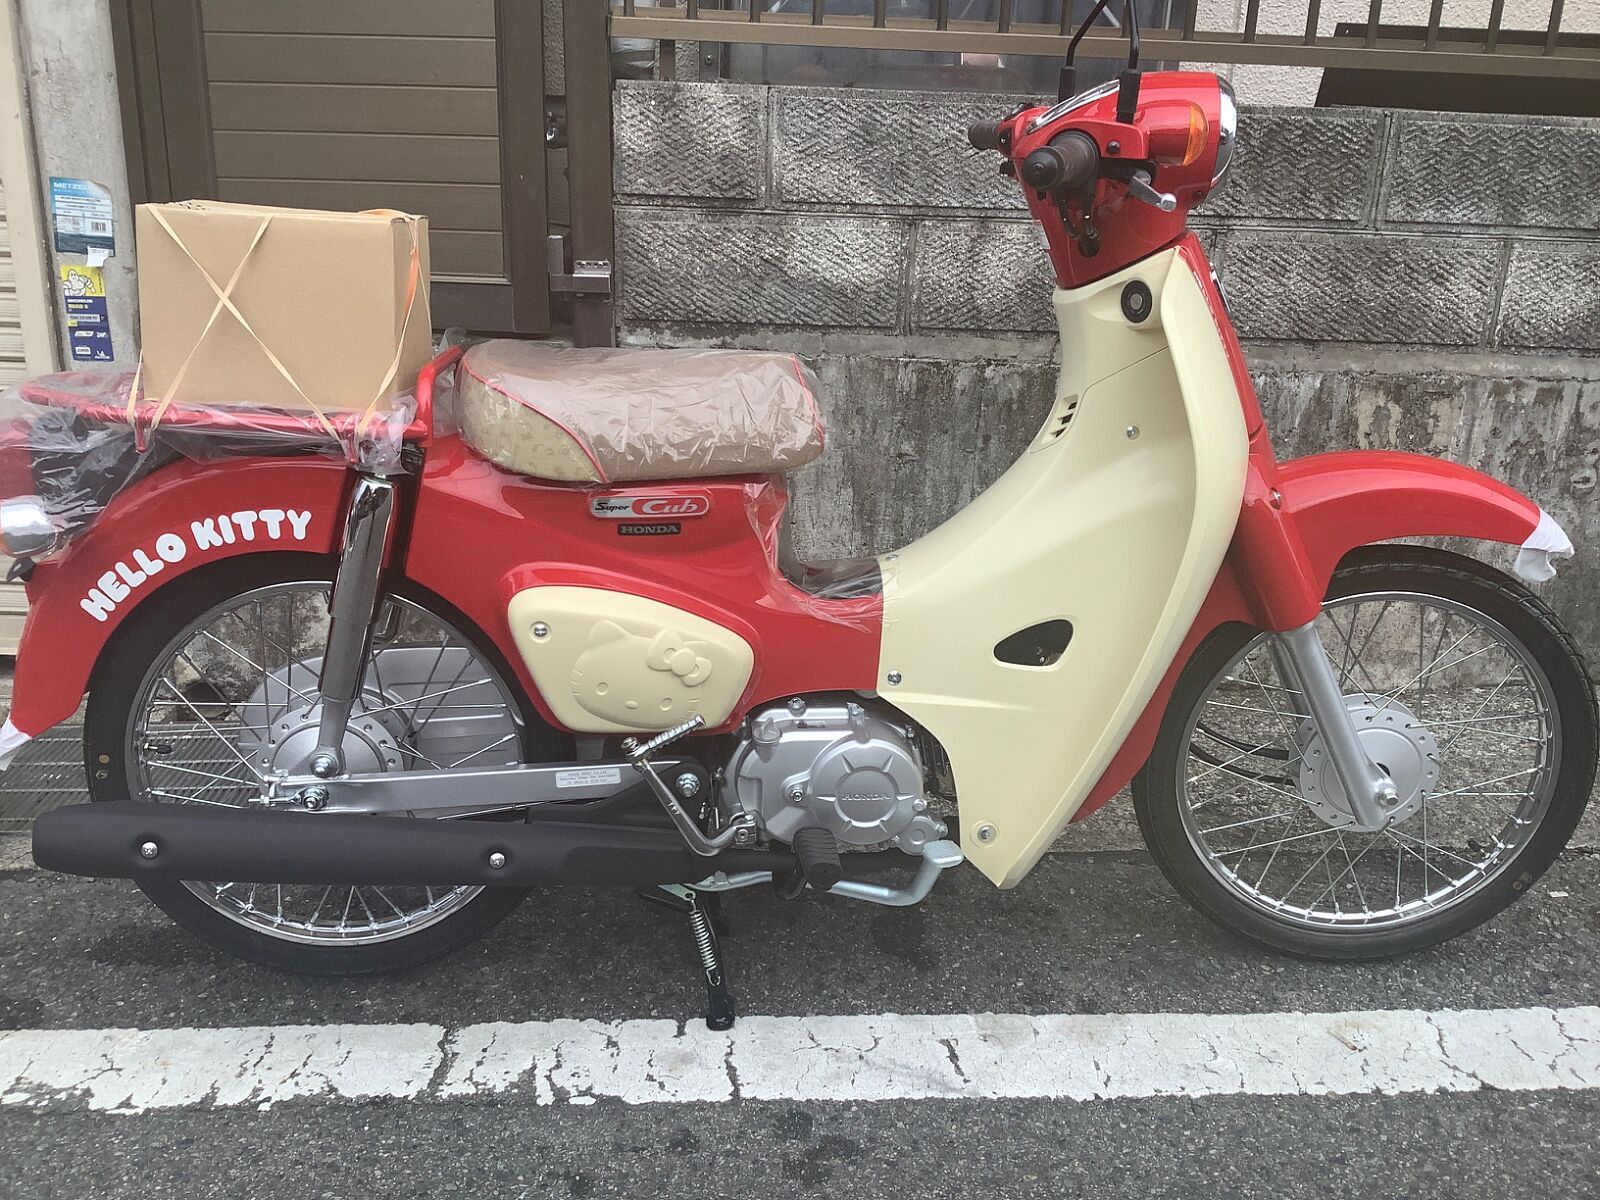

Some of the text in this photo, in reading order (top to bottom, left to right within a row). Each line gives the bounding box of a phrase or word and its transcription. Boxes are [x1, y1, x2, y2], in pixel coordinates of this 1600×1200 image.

[594, 499, 698, 514] Super Cub
[620, 525, 679, 534] HONDA
[80, 509, 312, 622] HELLO KITTY
[841, 792, 891, 801] HONDA
